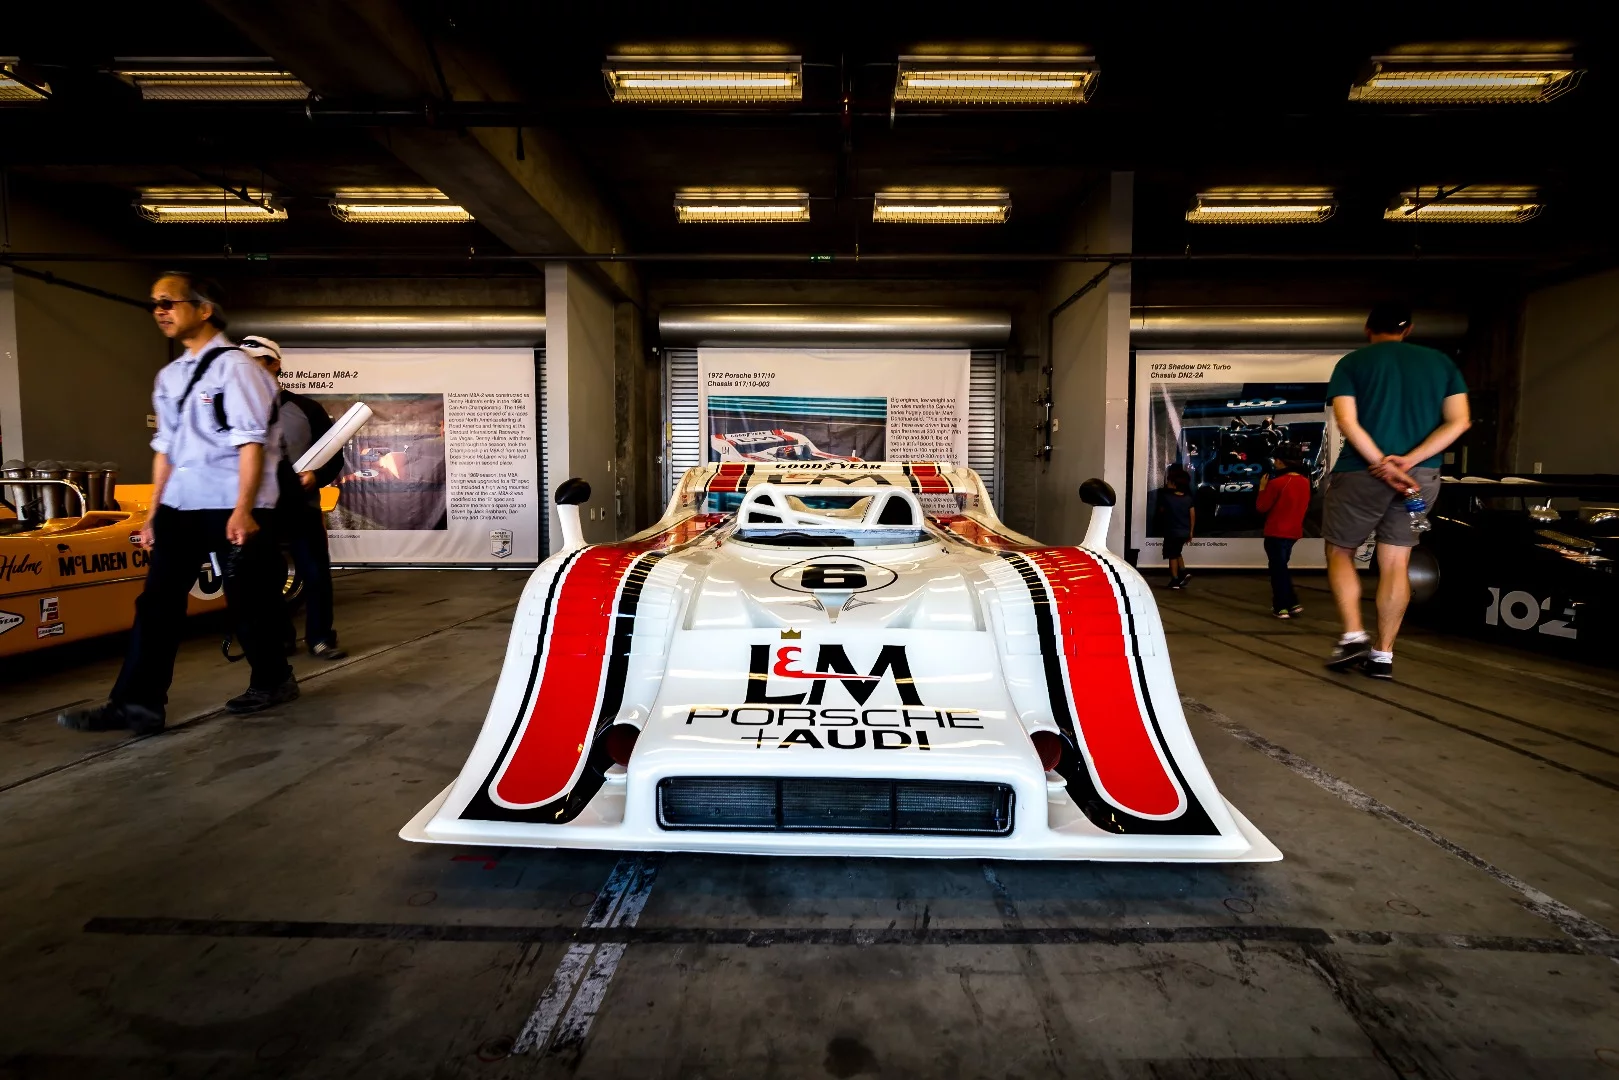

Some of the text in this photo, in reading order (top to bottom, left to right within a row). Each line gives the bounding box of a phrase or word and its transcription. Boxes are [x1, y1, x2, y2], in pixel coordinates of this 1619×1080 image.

[1220, 484, 1254, 492] 102
[0, 554, 43, 581] Hulme
[132, 549, 154, 568] CA
[801, 563, 867, 589] 6
[1485, 587, 1578, 640] 102
[685, 706, 984, 729] PORSCHE
